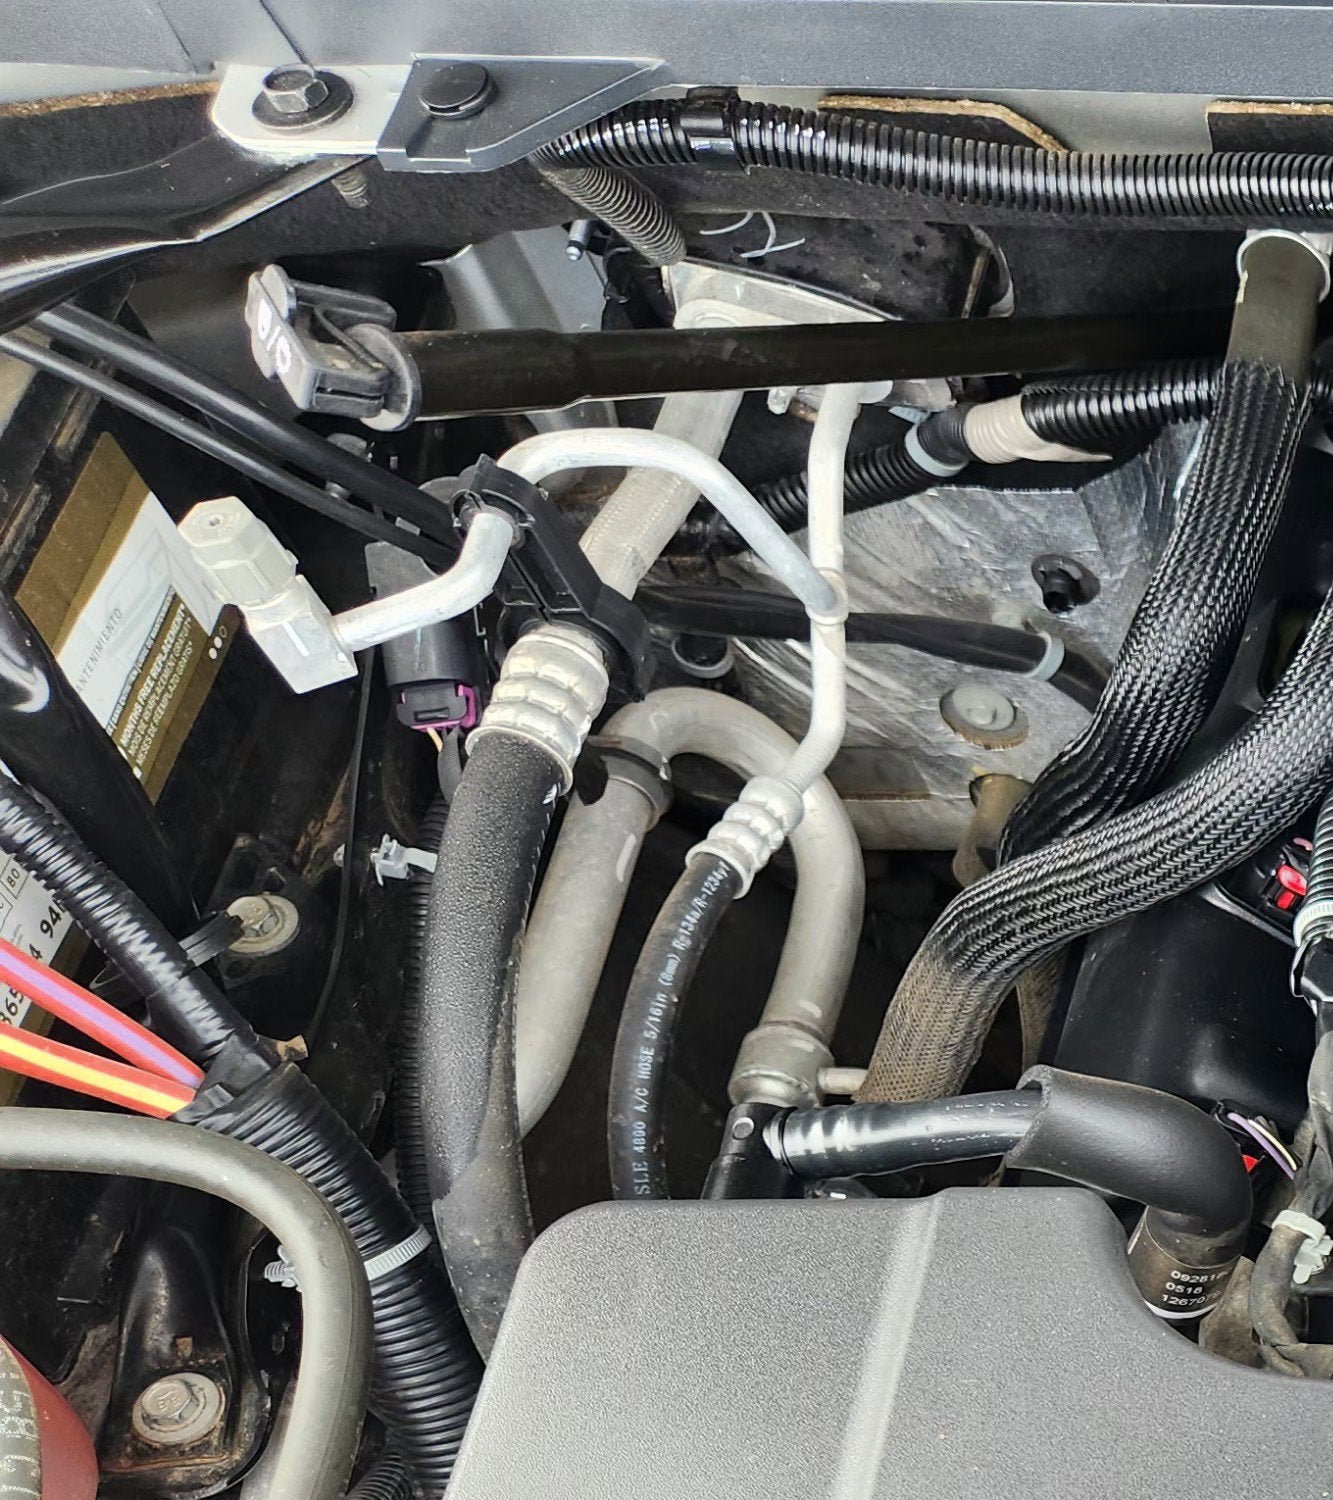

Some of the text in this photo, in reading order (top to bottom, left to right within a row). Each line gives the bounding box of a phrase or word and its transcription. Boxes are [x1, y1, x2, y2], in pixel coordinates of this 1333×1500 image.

[76, 606, 123, 693] ANTENIMIENTO
[137, 675, 155, 703] FREE
[637, 1045, 657, 1081] HOSE
[636, 1087, 651, 1113] A/C
[633, 1161, 650, 1196] SLE
